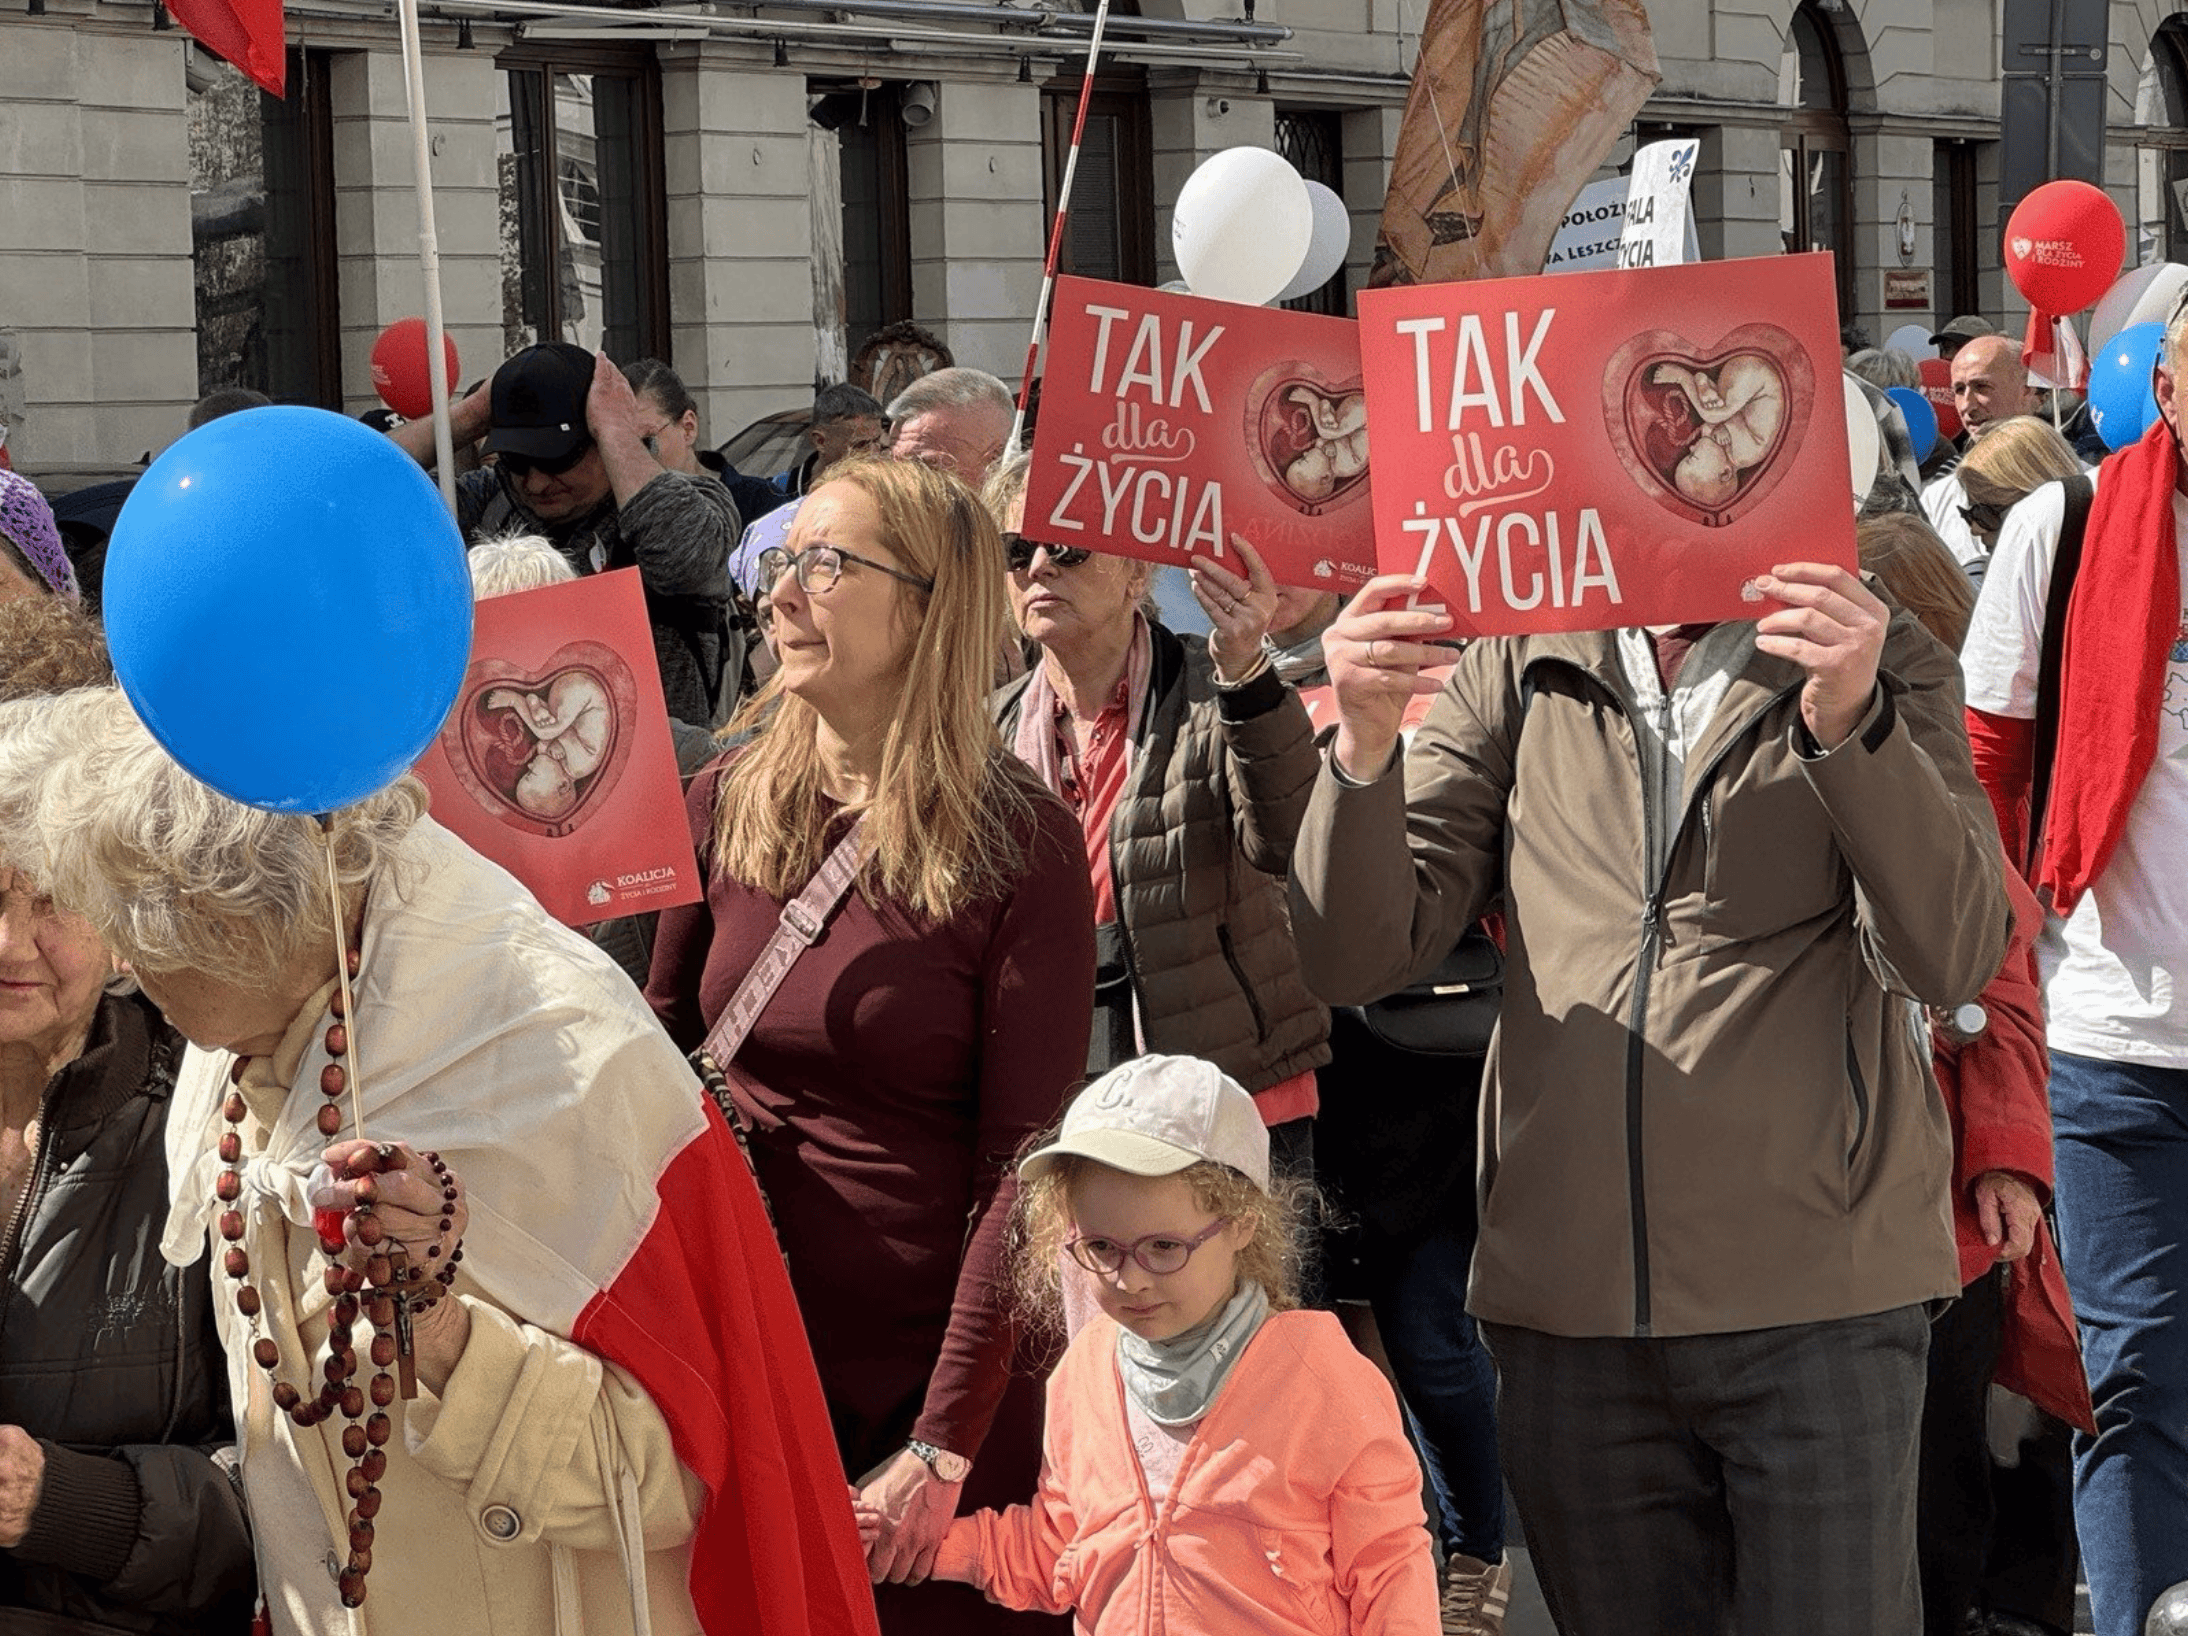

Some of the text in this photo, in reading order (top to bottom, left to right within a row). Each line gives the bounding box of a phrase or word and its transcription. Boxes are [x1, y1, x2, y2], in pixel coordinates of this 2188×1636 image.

[1617, 239, 1654, 269] YCIA
[2035, 241, 2073, 252] MARSZ
[1085, 304, 1226, 414] TAK
[1397, 308, 1567, 432] TAK
[1102, 401, 1195, 464] dla
[1444, 432, 1554, 518] dla
[1050, 443, 1223, 558] ŻYCIA
[1402, 500, 1622, 614] ŻYCIA
[617, 866, 676, 887] KOALICJA
